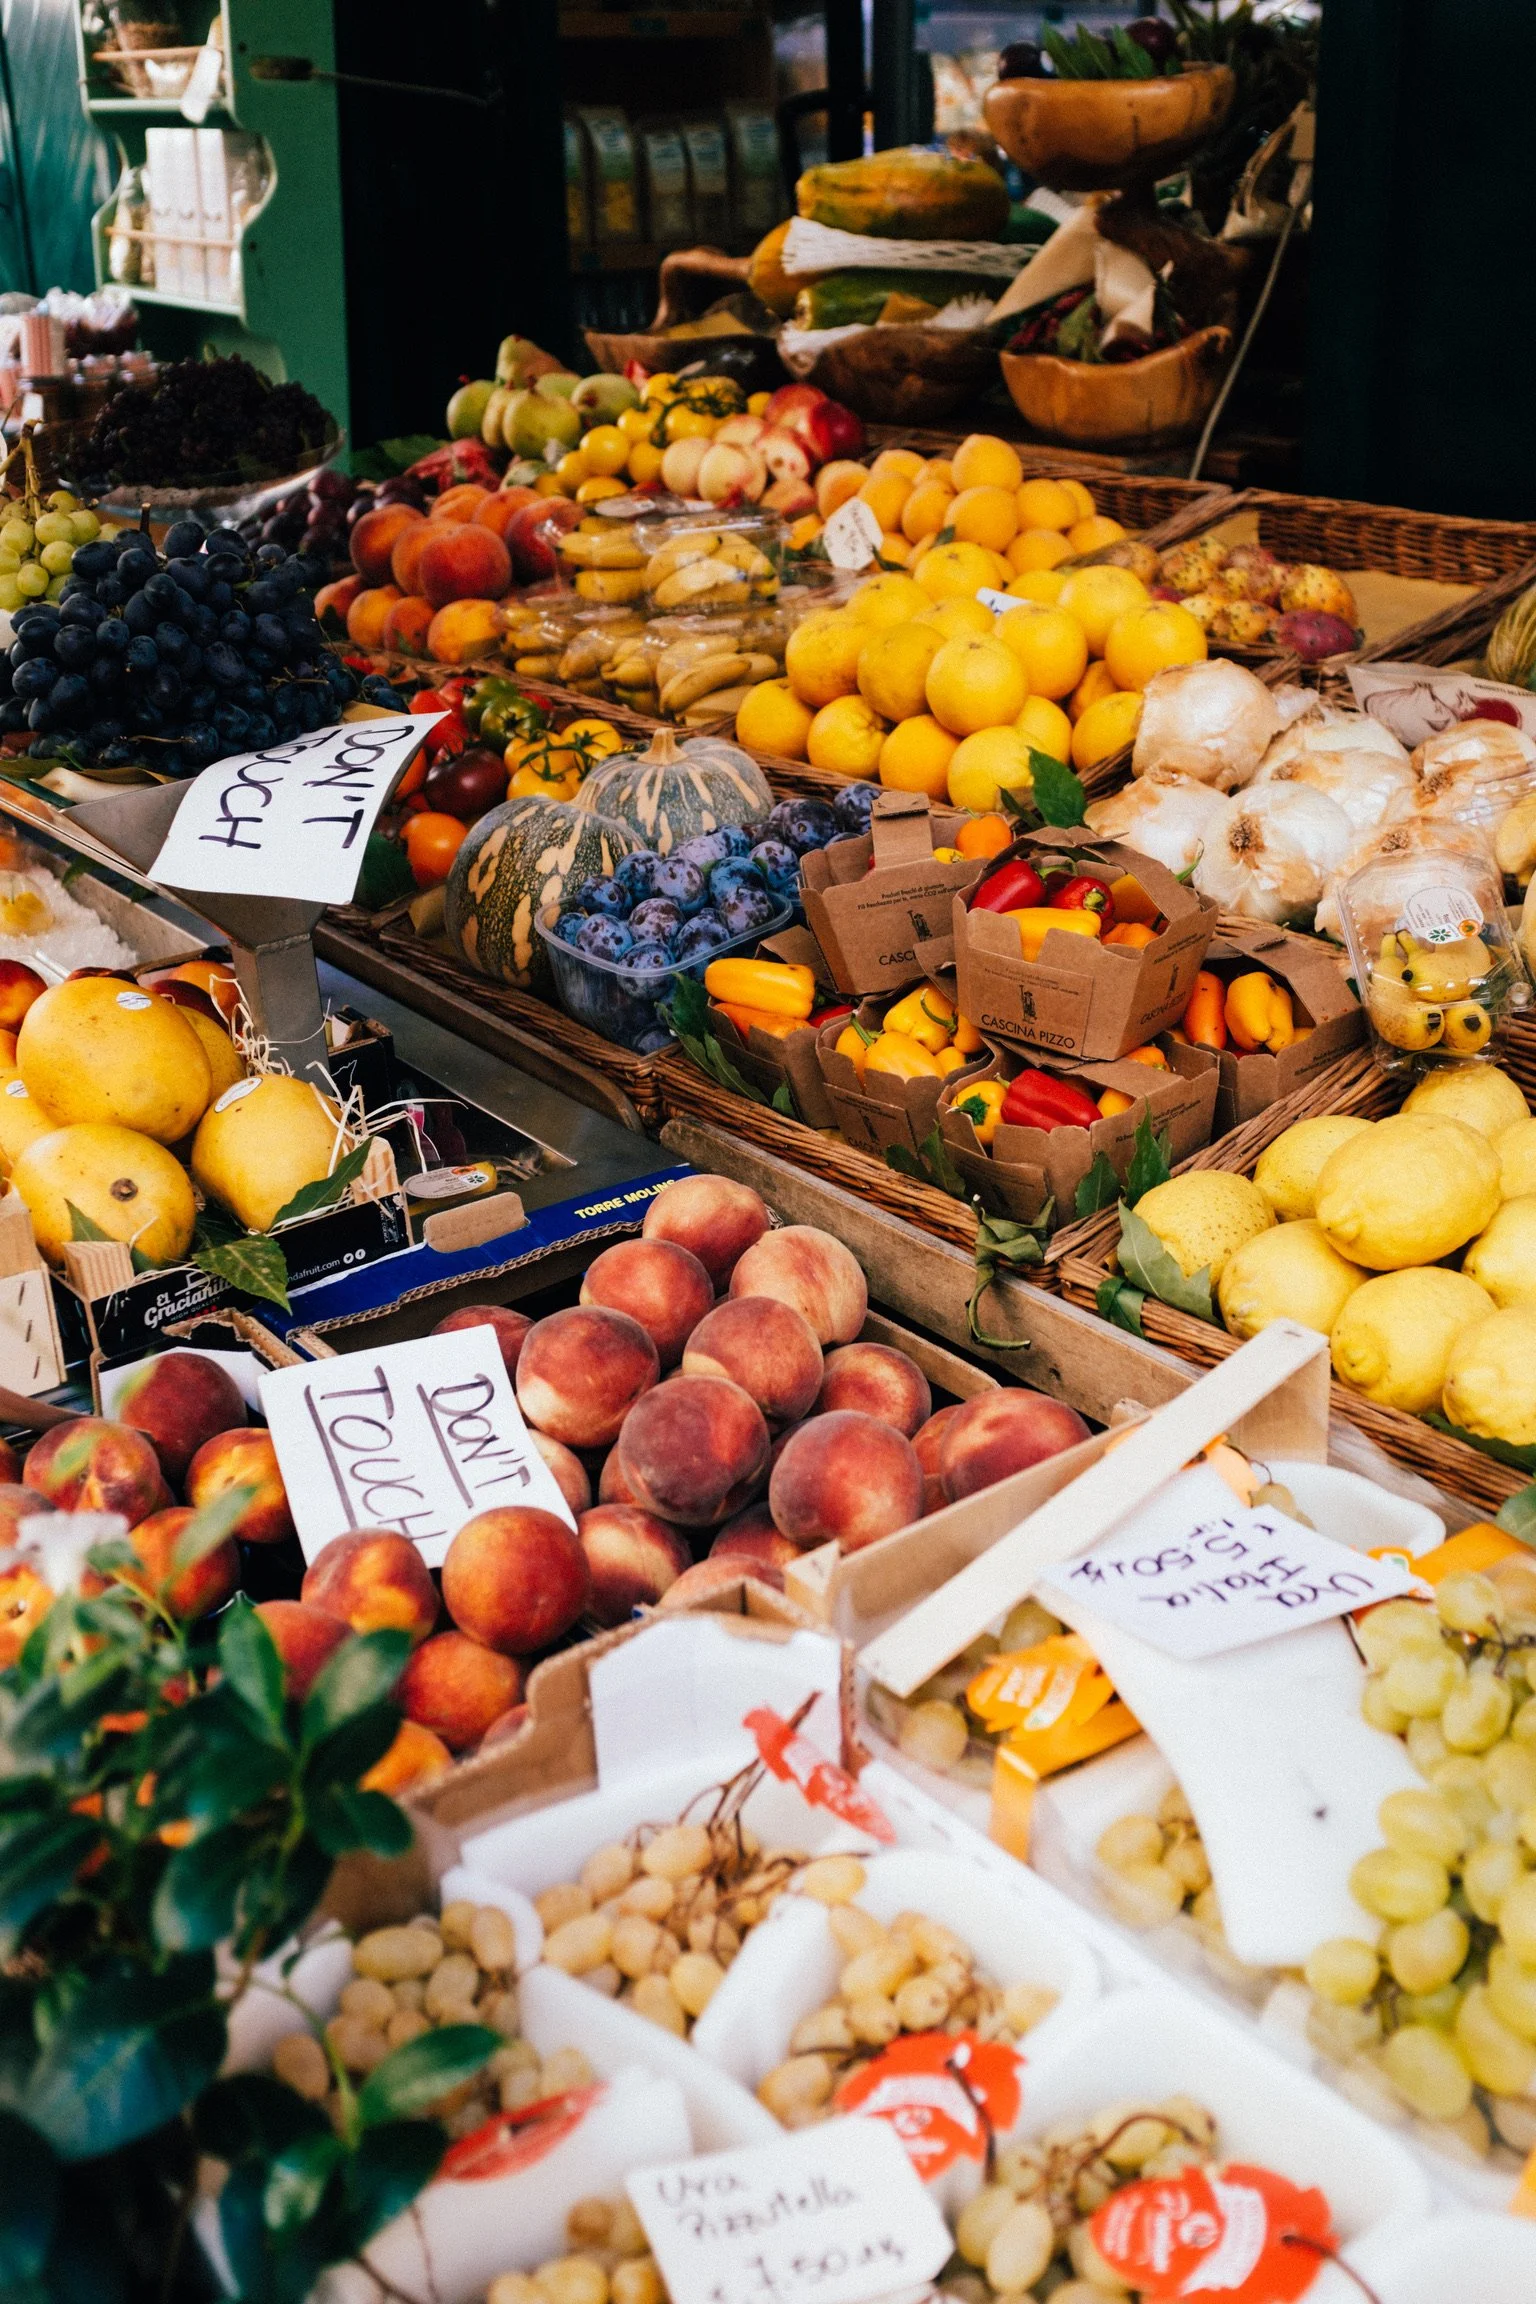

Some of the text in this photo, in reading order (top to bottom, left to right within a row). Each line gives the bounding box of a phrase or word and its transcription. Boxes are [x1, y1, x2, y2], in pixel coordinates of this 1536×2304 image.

[199, 729, 343, 850] TOUCH
[302, 725, 414, 849] DON'T
[981, 1014, 1075, 1049] CASCINA PIZZO
[574, 1197, 626, 1219] TORRE
[156, 1291, 171, 1307] El
[320, 1365, 447, 1541] TOUCH
